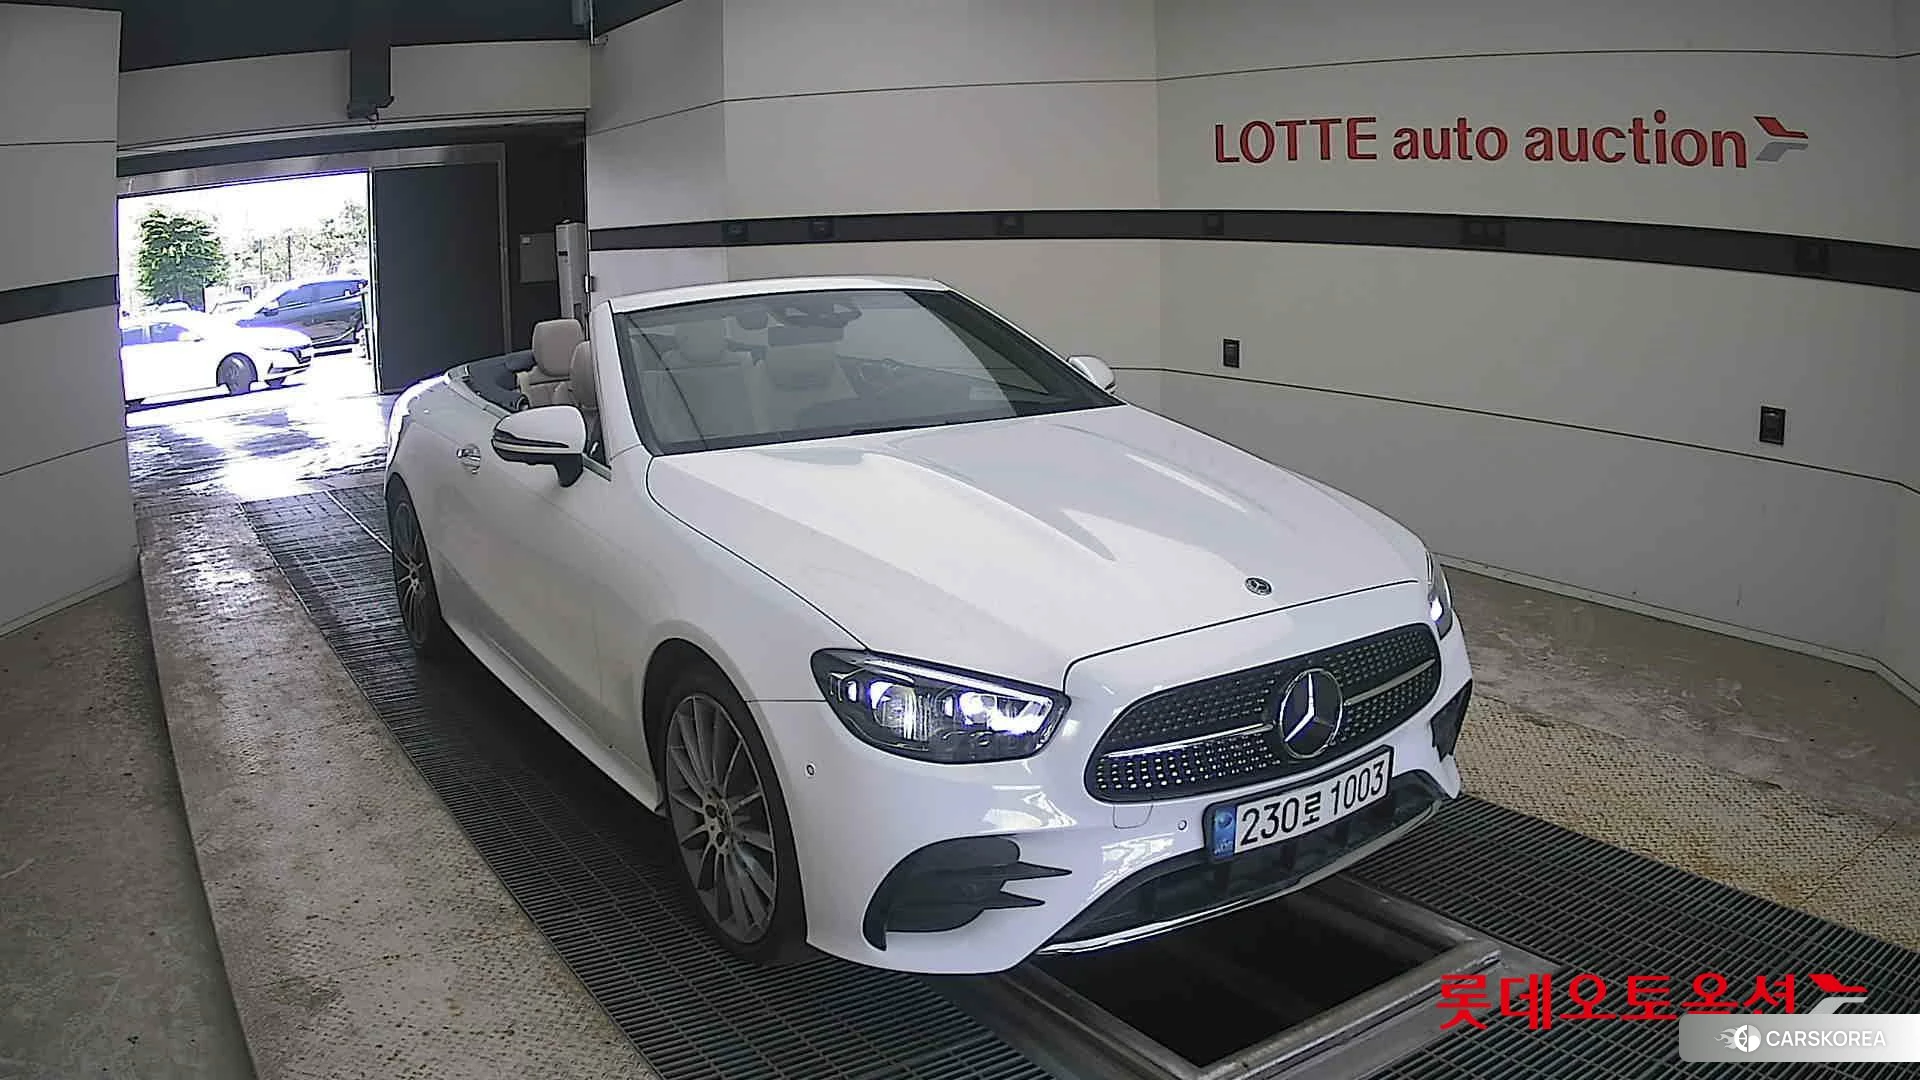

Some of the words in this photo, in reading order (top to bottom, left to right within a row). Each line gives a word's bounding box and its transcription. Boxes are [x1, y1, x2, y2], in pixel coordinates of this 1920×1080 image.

[1214, 116, 1378, 163] LOTTE
[1392, 117, 1510, 161] auto
[1523, 110, 1749, 169] auction
[1240, 791, 1322, 846] 230로
[1330, 759, 1385, 816] 1003
